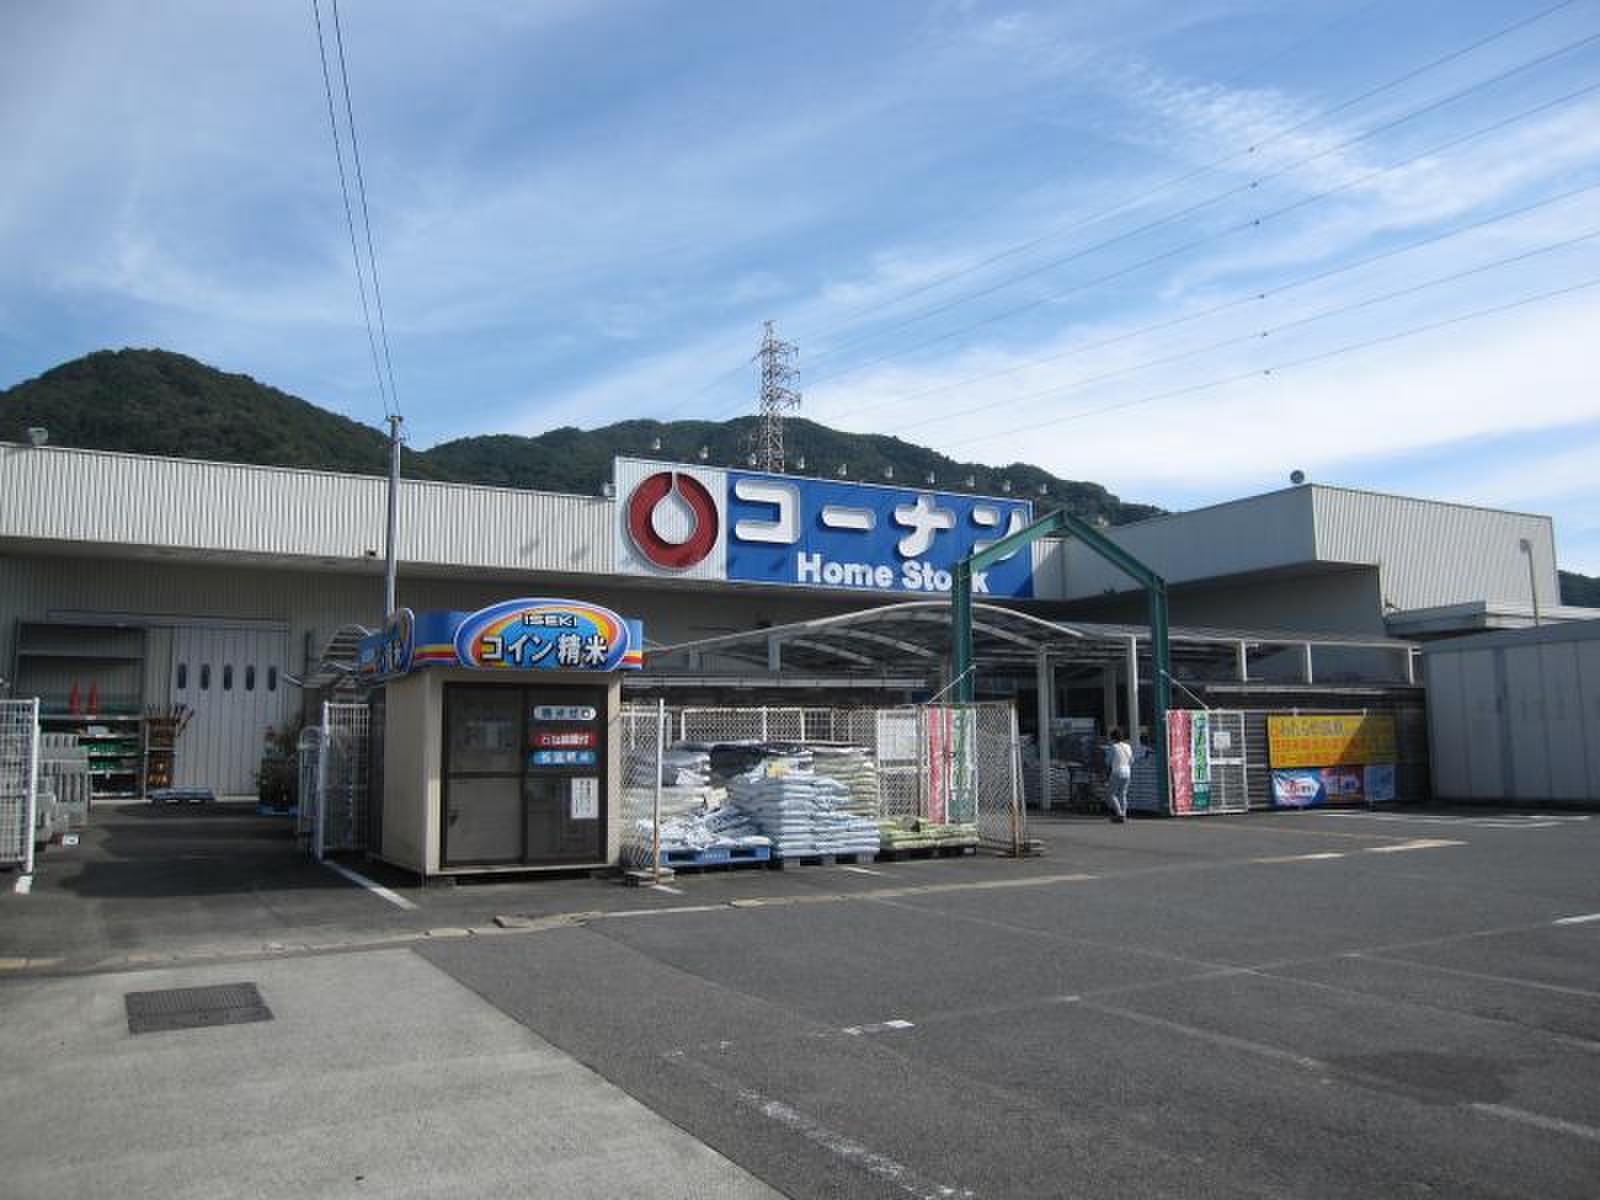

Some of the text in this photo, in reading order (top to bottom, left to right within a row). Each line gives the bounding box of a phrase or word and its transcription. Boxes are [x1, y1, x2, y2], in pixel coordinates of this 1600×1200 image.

[735, 479, 1026, 561] コーナン
[797, 551, 990, 593] Home Stok
[524, 615, 577, 627] ISEKI
[482, 633, 609, 665] コイン精米
